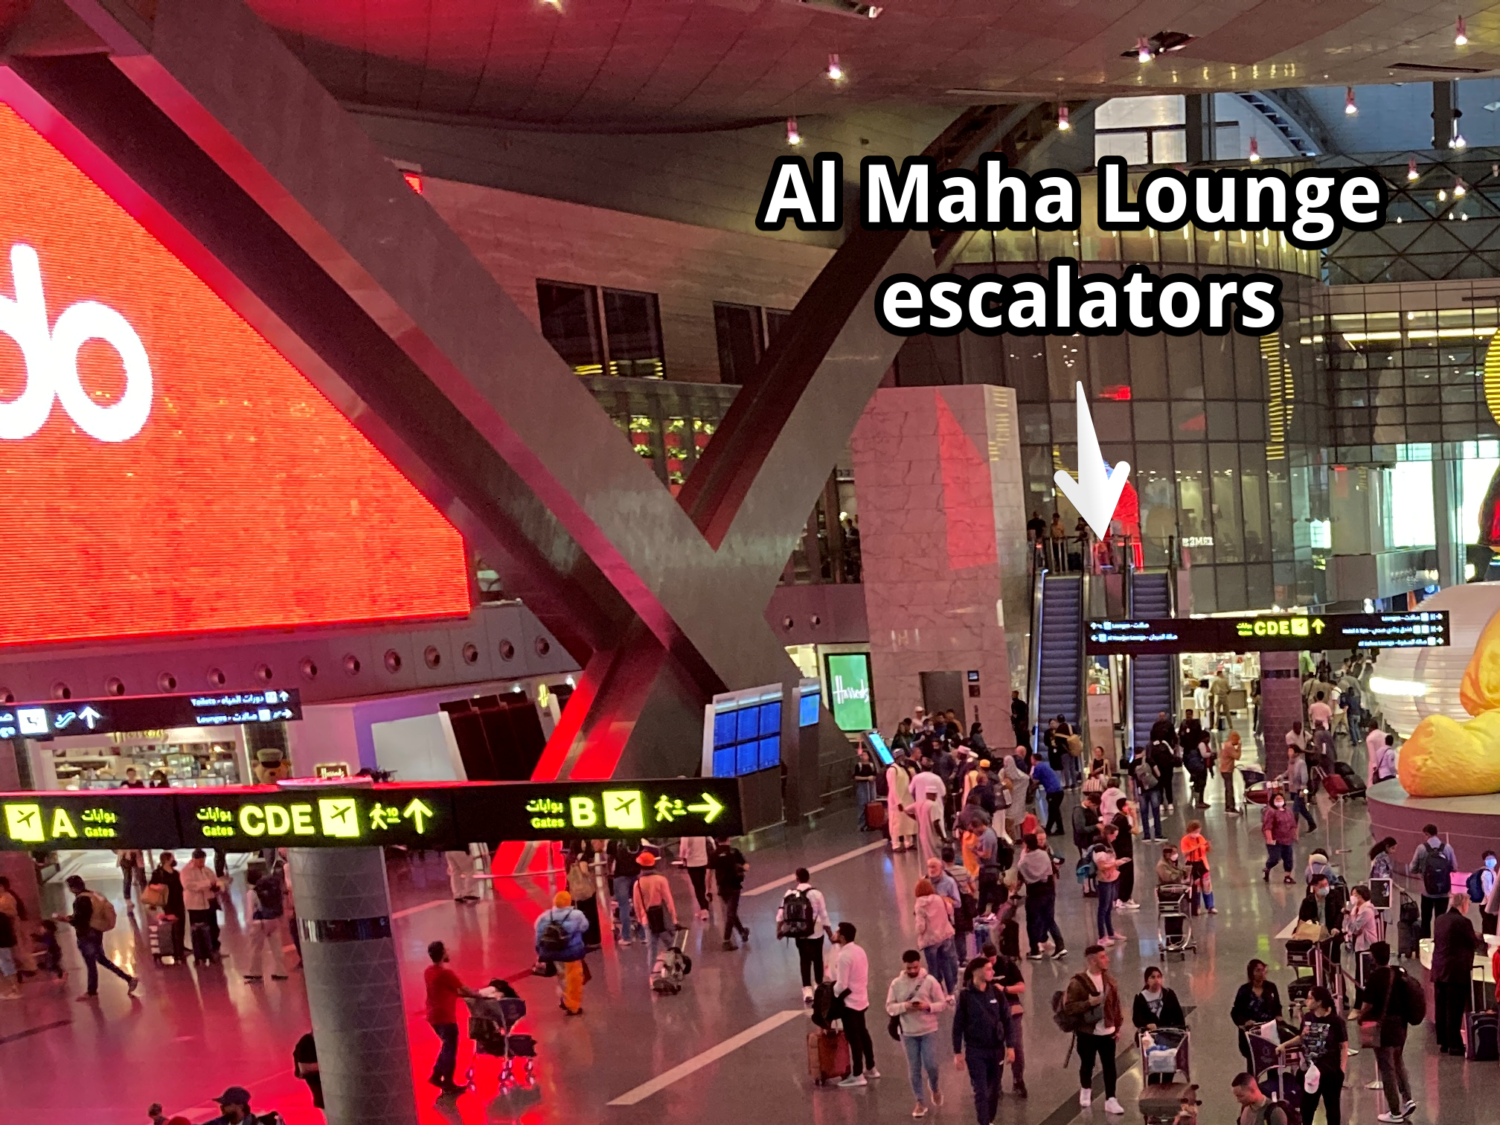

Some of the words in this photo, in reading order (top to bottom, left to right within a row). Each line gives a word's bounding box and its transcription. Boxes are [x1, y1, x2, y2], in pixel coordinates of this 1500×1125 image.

[1254, 620, 1290, 636] CDE
[833, 675, 869, 704] Harrods
[197, 806, 232, 822] بوابات
[386, 807, 399, 818] 10
[526, 799, 564, 814] بوابات
[569, 797, 599, 828] B
[52, 808, 78, 838] A
[82, 808, 116, 823] بوابات
[239, 804, 316, 837] CDE
[531, 818, 566, 829] Gates
[84, 827, 116, 838] Gates
[202, 826, 234, 837] Gates
